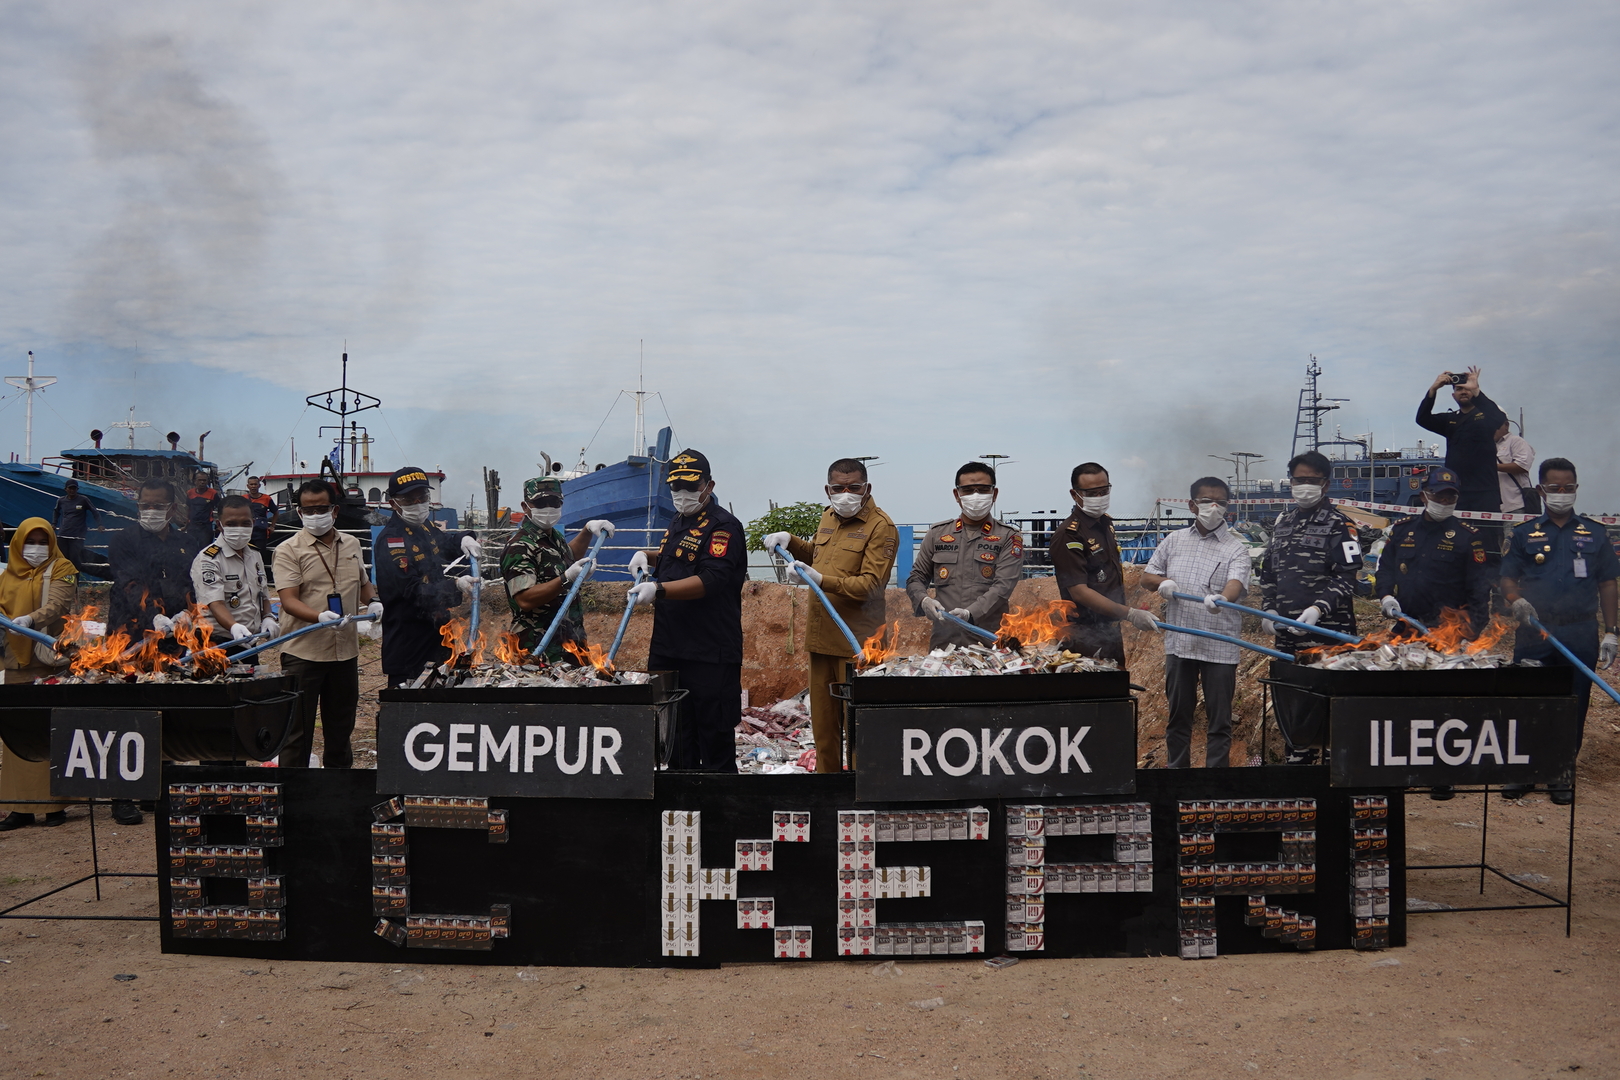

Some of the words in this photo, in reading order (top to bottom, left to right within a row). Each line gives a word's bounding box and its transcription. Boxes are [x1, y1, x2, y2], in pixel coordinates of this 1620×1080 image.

[396, 472, 428, 485] CUSTOMS
[978, 544, 1001, 552] POLRI
[1342, 541, 1361, 563] P
[66, 730, 144, 780] AYO
[405, 723, 622, 774] GEMPUR
[903, 727, 1090, 776] ROKOK
[1371, 720, 1529, 765] ILEGAL
